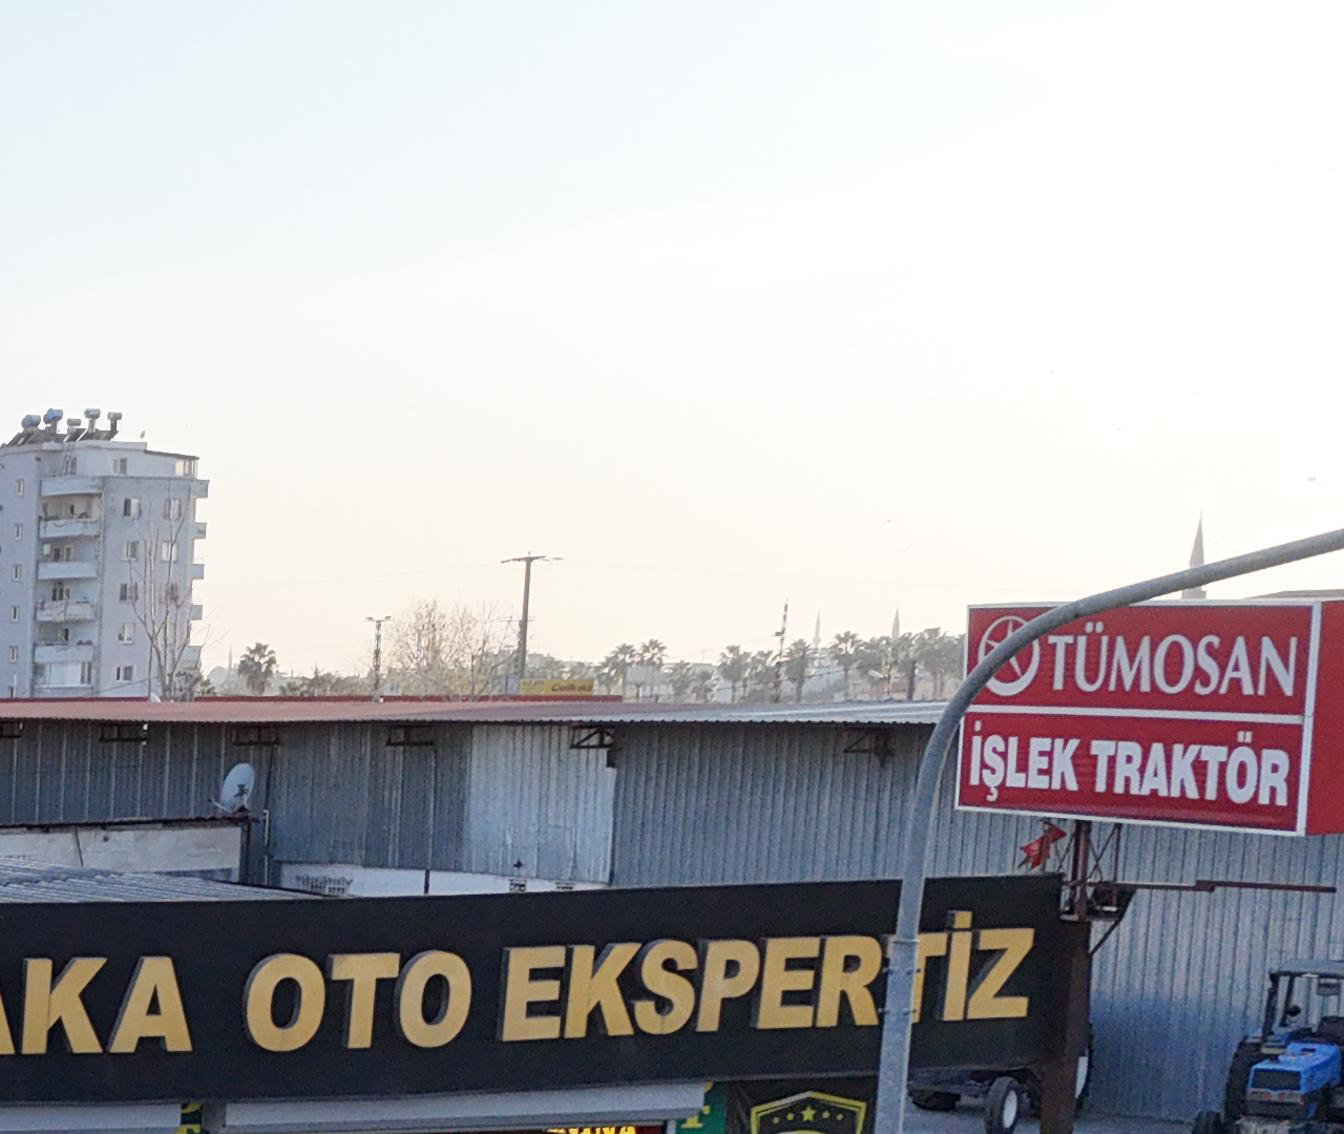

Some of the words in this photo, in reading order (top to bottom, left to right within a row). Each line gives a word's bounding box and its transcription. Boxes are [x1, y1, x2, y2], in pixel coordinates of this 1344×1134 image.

[1047, 621, 1299, 697] TÜMOSAN
[969, 721, 1081, 802] İŞLEK
[1090, 730, 1291, 806] TRAKTÖR
[243, 950, 473, 1052] OTO
[497, 909, 1035, 1043] EKSPERTİZ
